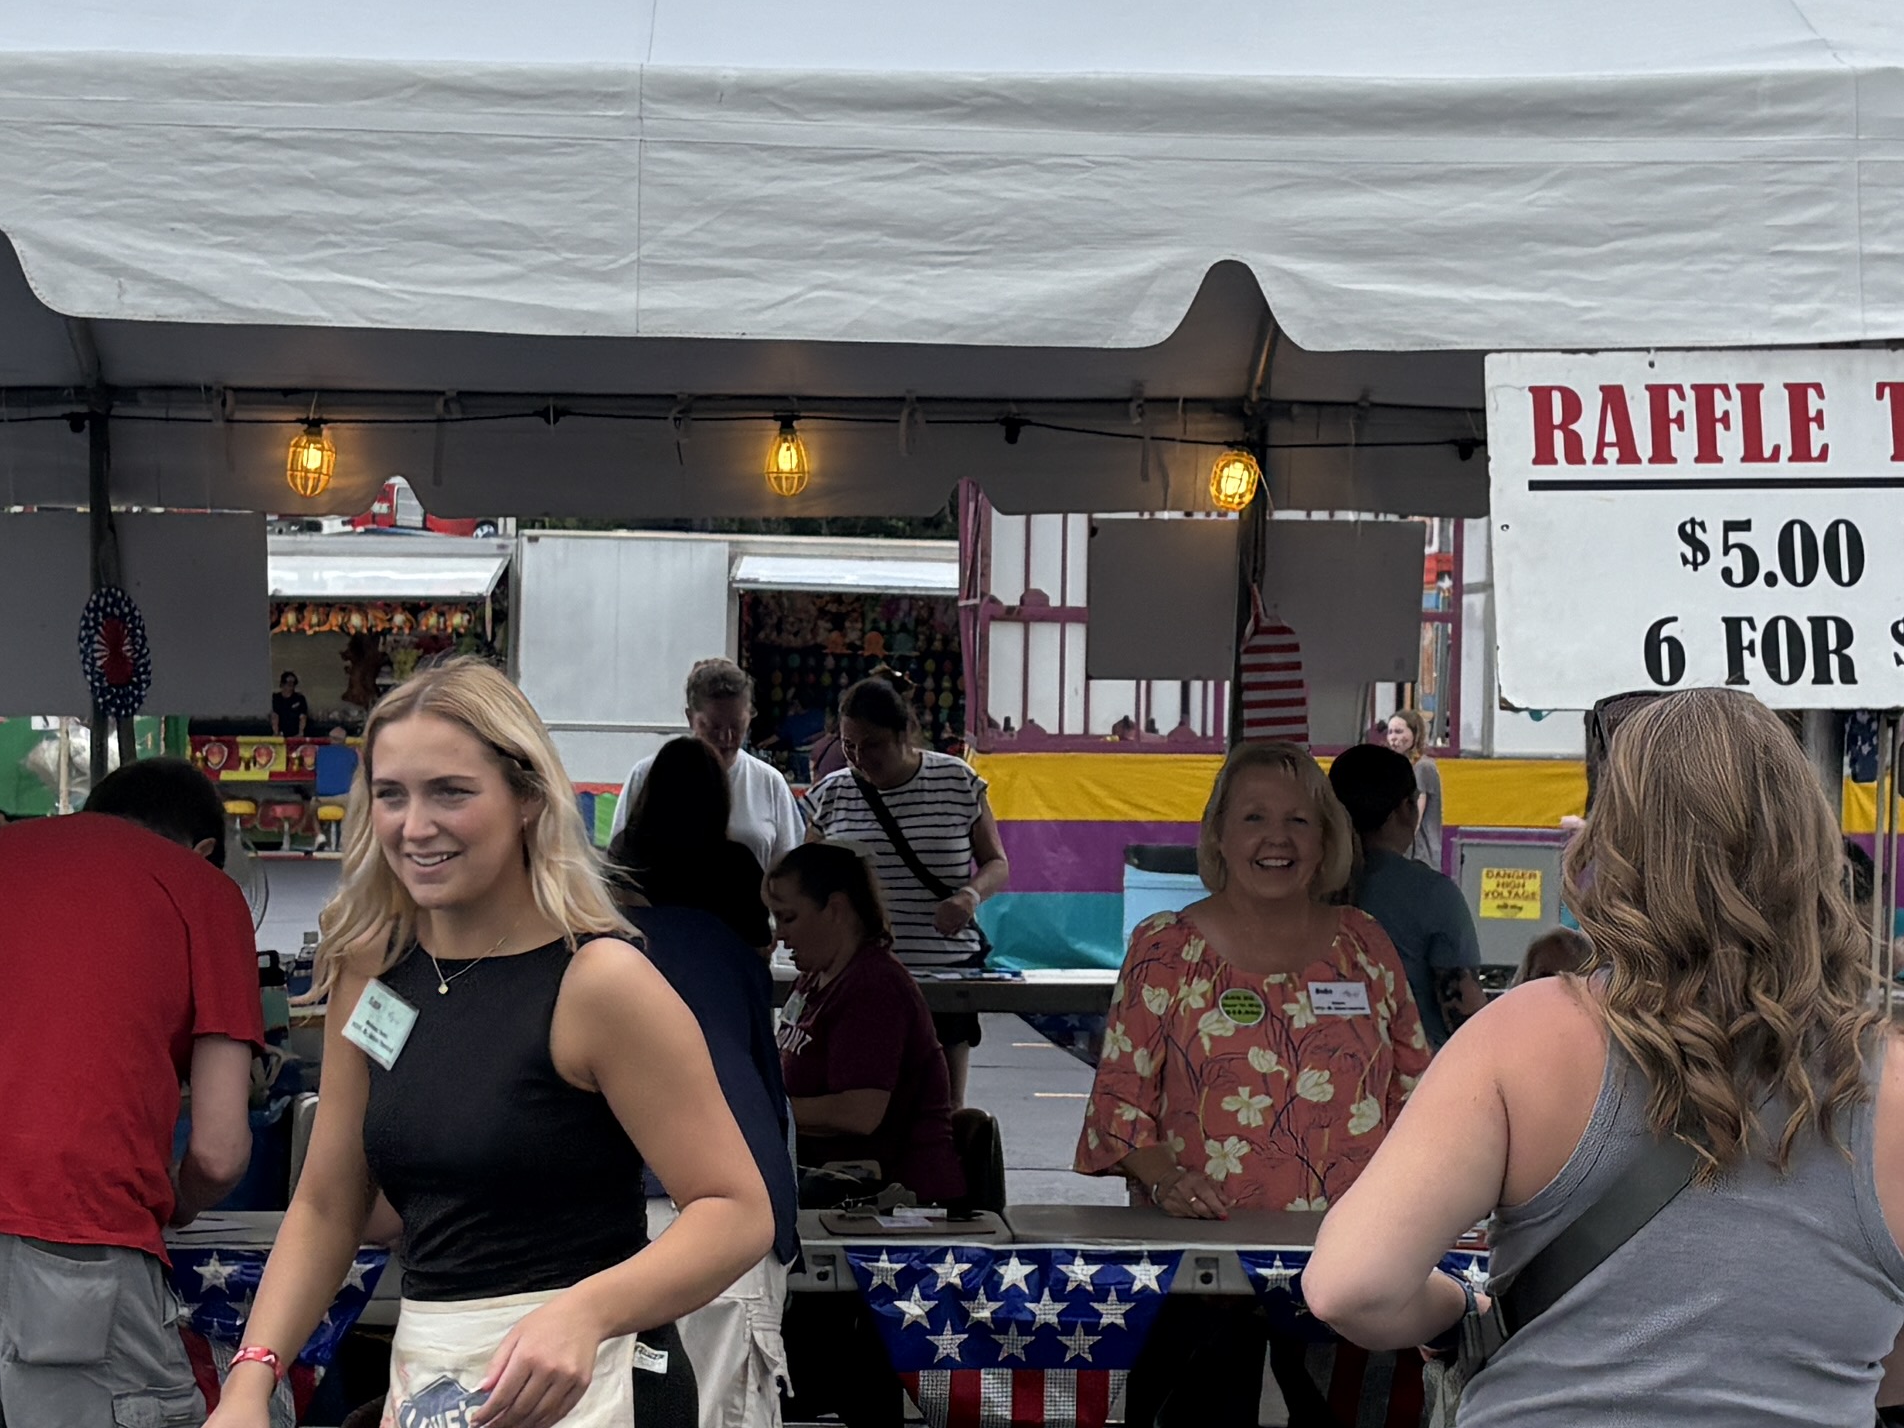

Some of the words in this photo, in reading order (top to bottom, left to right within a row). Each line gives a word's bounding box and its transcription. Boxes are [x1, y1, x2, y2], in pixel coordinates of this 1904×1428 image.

[1528, 381, 1829, 465] RAFFLE
[1677, 515, 1865, 588] $5.00
[1643, 615, 1687, 687] 6
[1722, 616, 1858, 686] FOR
